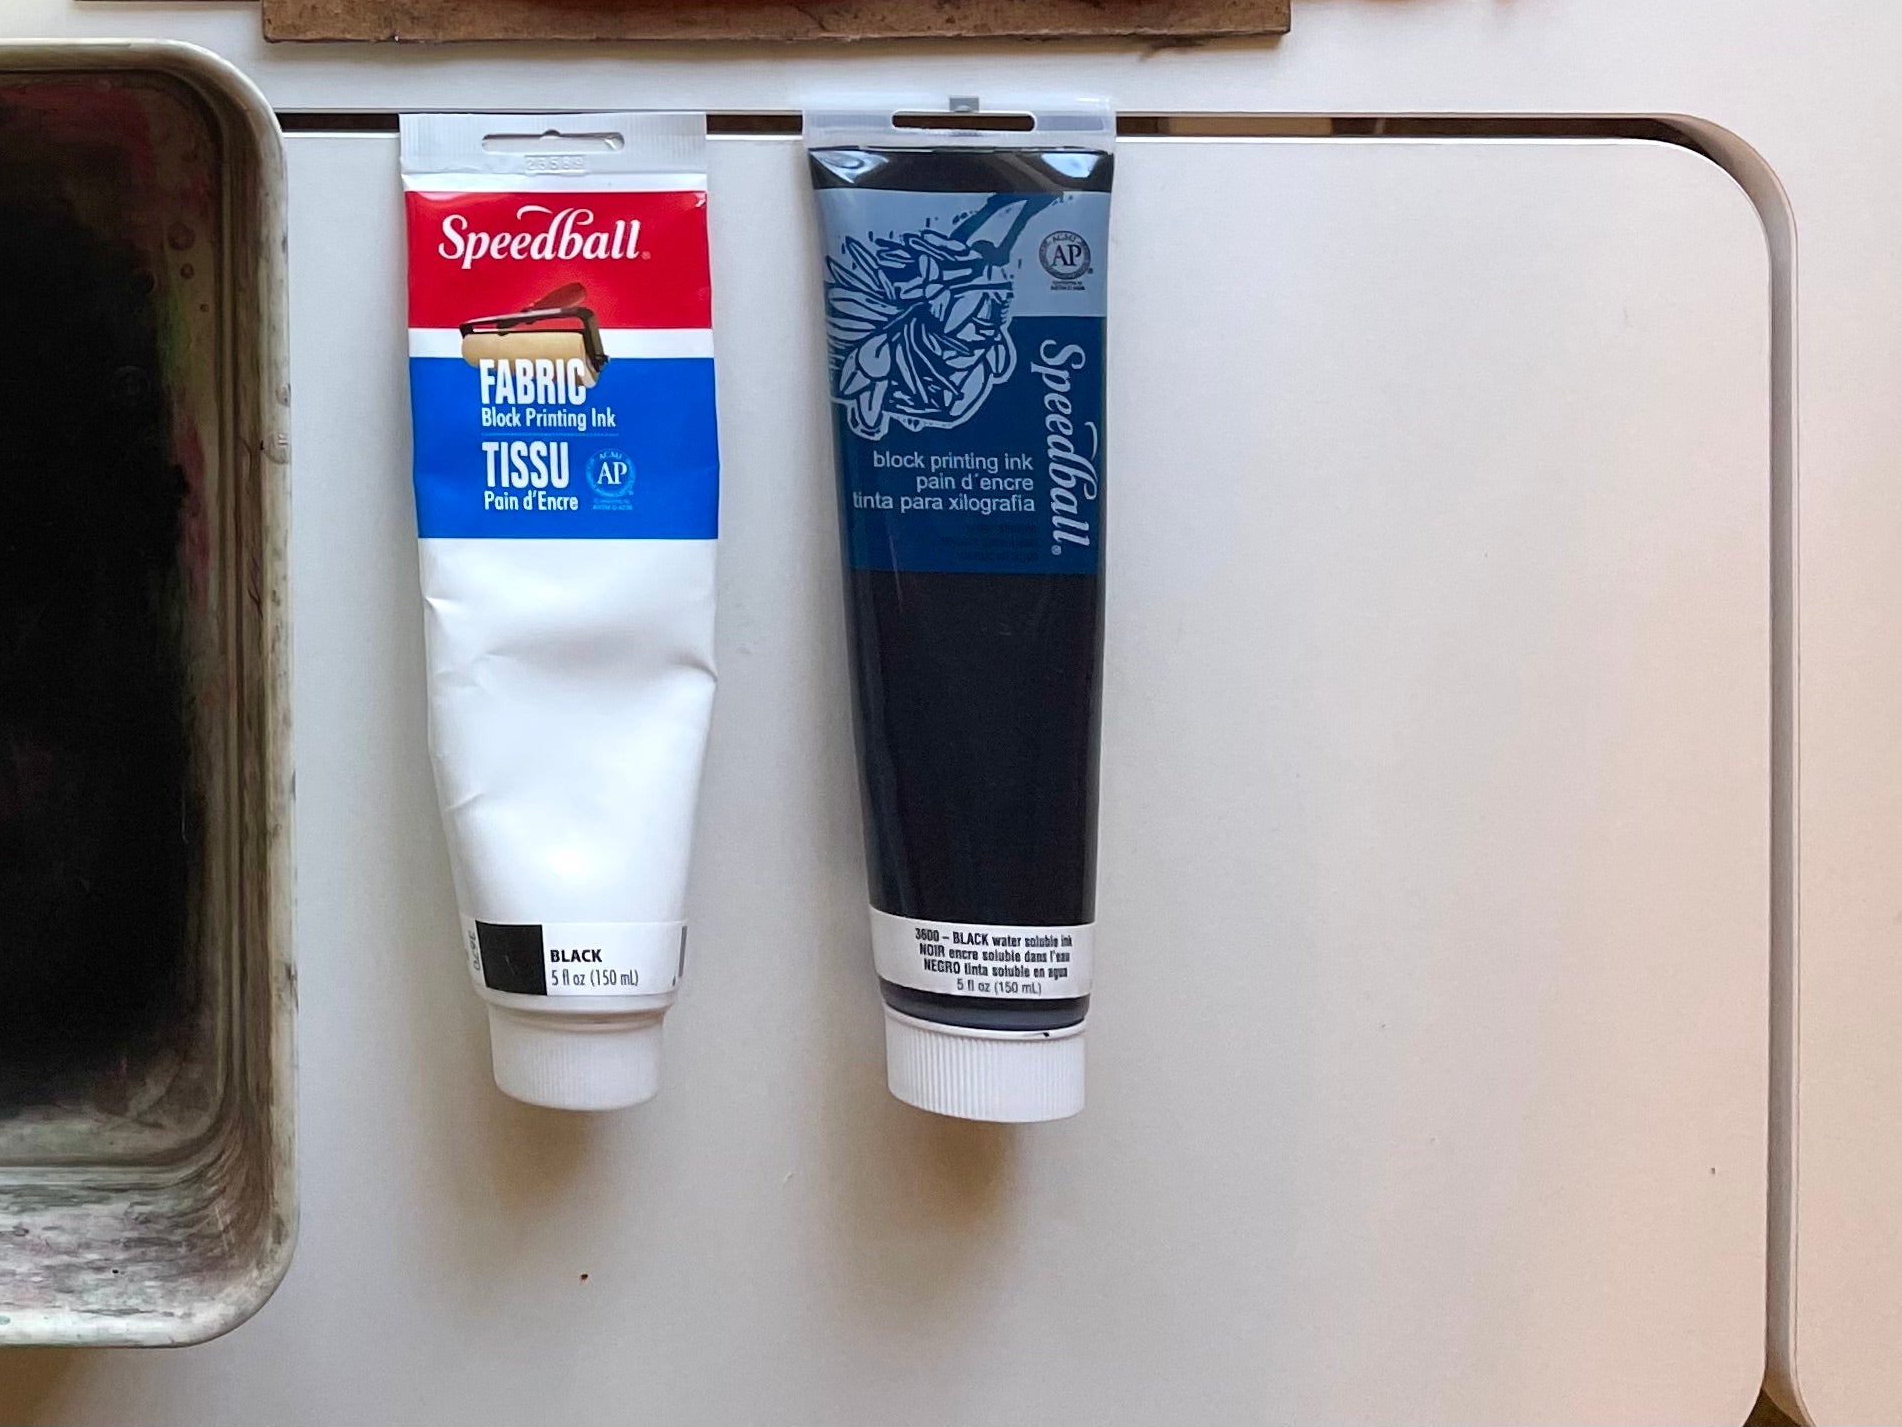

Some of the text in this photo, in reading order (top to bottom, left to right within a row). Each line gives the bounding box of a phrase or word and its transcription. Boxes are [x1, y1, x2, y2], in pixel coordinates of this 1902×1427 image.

[438, 205, 640, 269] Speedball
[1051, 244, 1082, 266] AP
[479, 358, 587, 405] FABRIC
[481, 406, 616, 431] Block Printing Ink
[1031, 339, 1098, 549] Speedball
[481, 440, 570, 488] TISSU
[597, 461, 628, 484] AP
[873, 450, 1034, 474] block printing ink
[916, 473, 956, 493] pain
[484, 489, 579, 511] Pain d'Encre
[852, 491, 894, 509] tinta
[900, 495, 943, 514] para
[952, 931, 989, 946] BLACK
[992, 935, 1021, 947] water
[1024, 935, 1058, 947] soluble
[1061, 935, 1073, 947] ink
[550, 949, 602, 963] BLACK
[919, 943, 945, 958] NOIR
[949, 948, 978, 961] encre
[982, 949, 1021, 962] soluble
[1024, 950, 1047, 962] dans
[551, 968, 639, 987] 5 fl oz (150 mL)
[923, 958, 960, 975] NEGRO
[964, 963, 989, 976] tinta
[992, 964, 1030, 978] soluble
[1033, 967, 1045, 978] en
[956, 978, 964, 991] 5
[967, 979, 975, 991] fl
[978, 982, 990, 992] oz
[994, 981, 1019, 995] (150
